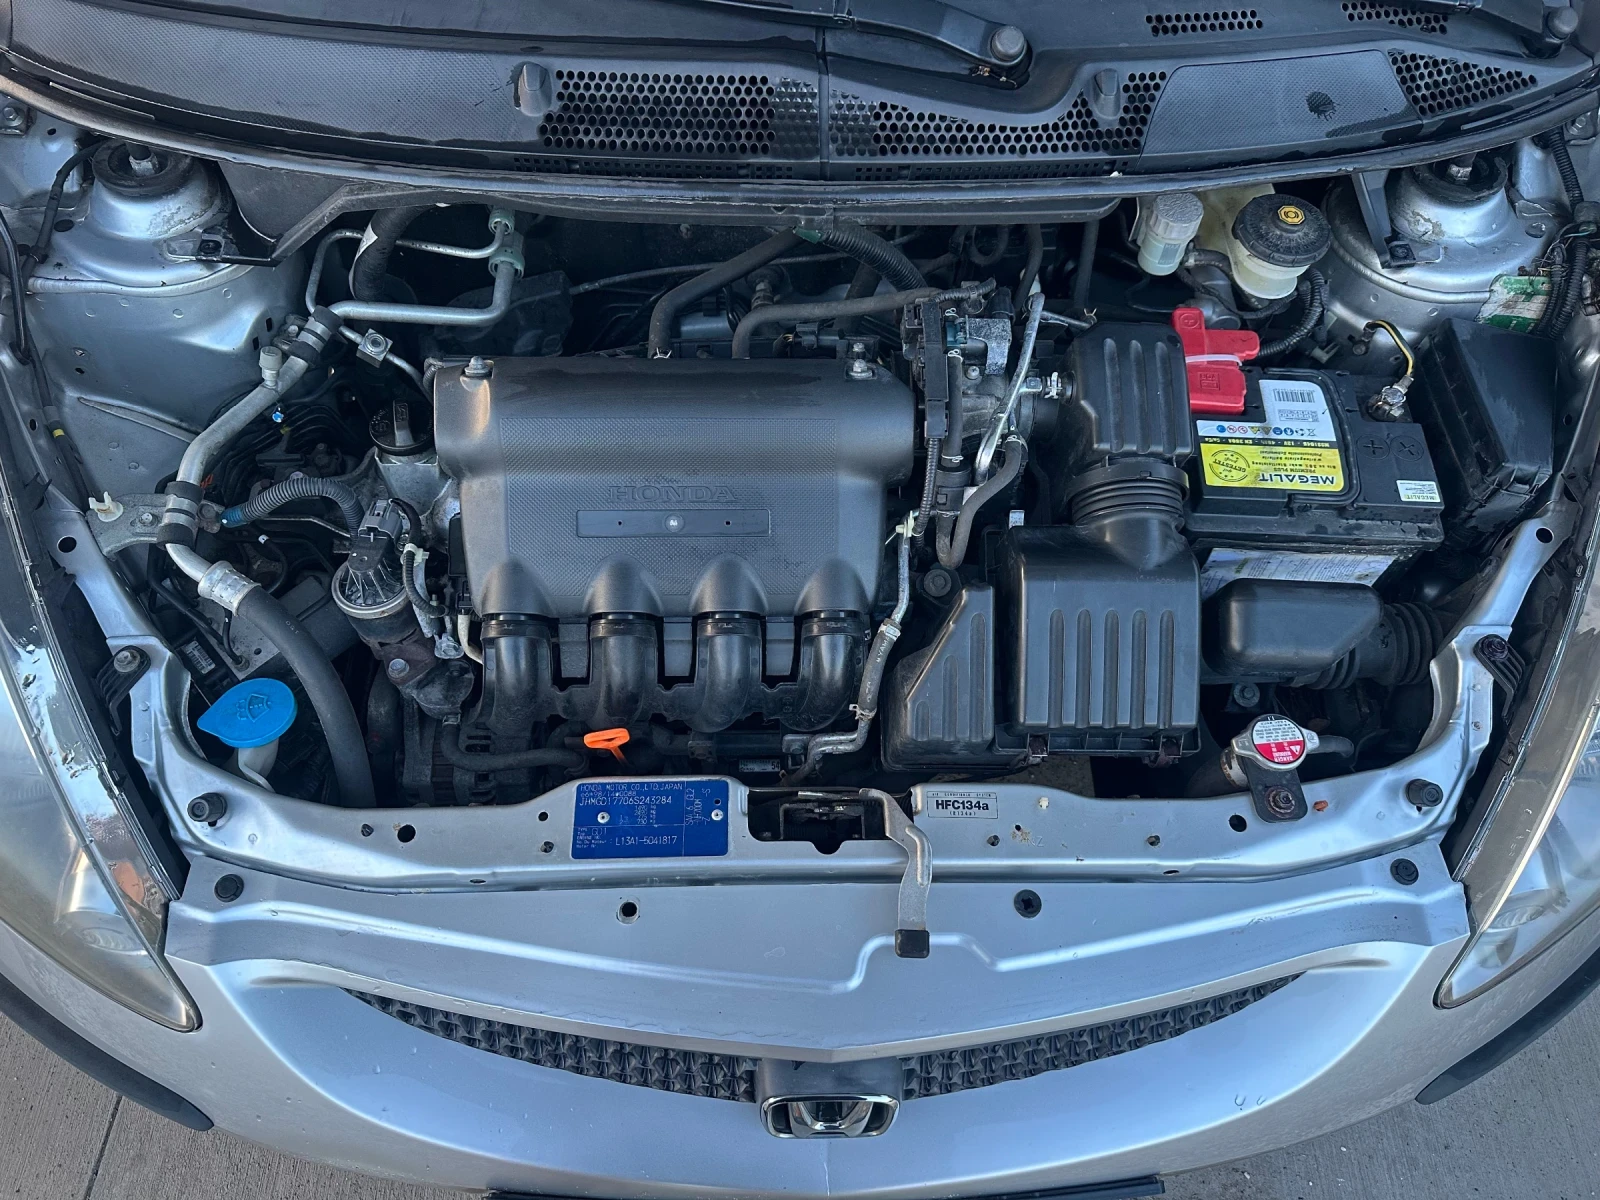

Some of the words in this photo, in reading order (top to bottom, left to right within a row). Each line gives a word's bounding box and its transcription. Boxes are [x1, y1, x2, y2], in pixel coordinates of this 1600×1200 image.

[1212, 458, 1246, 473] GETESTET
[1258, 473, 1334, 484] MEGALIT
[609, 485, 736, 501] HONDA
[936, 800, 989, 810] HFC134a
[616, 836, 677, 846] L13A1-5041817
